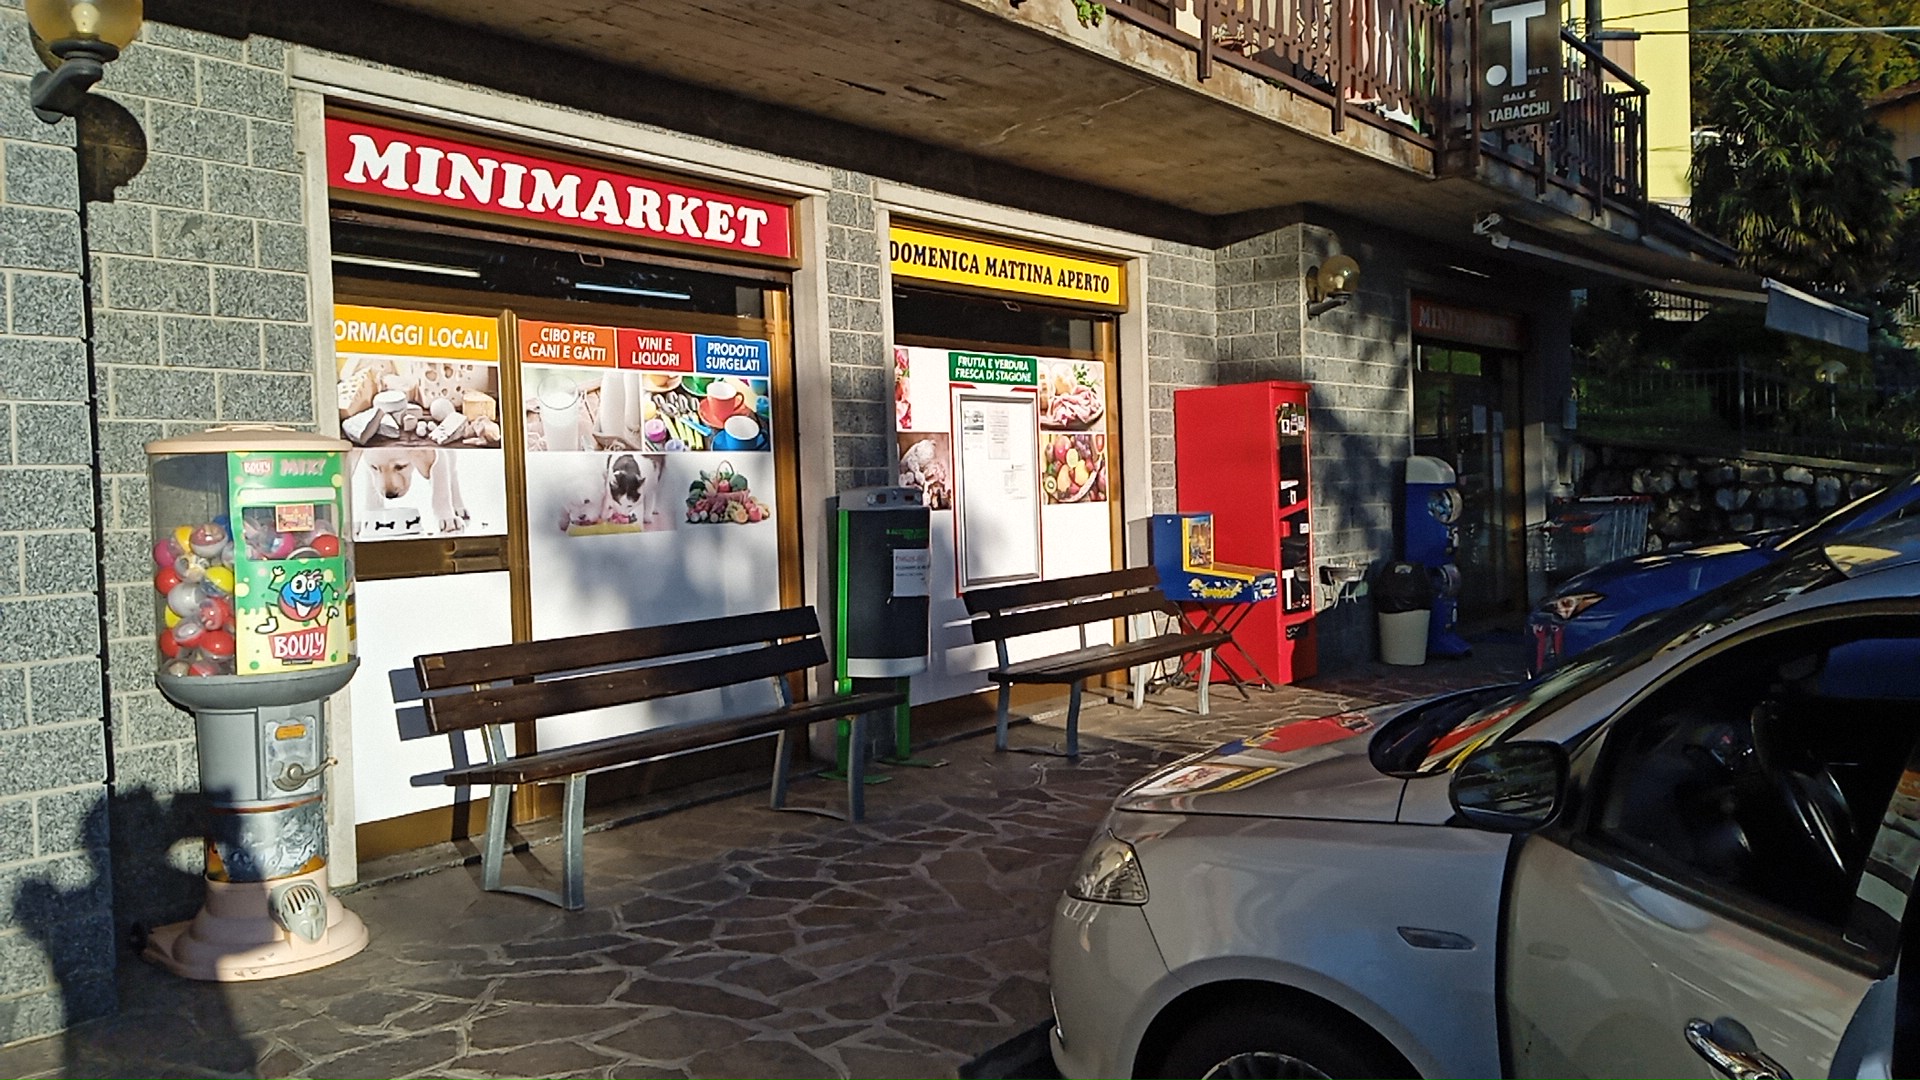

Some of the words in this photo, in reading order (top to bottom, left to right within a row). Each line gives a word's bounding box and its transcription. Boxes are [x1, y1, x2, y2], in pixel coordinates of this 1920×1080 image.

[1491, 0, 1546, 87] T
[1502, 91, 1526, 103] SALI
[1528, 89, 1537, 98] E
[1488, 101, 1550, 123] TABACCHI
[343, 133, 769, 247] MINIMARKET
[889, 240, 980, 275] DOMENICA
[984, 256, 1053, 286] MATTINA
[1057, 269, 1110, 294] APERTO
[428, 326, 489, 350] LOCALI
[540, 327, 570, 343] CIBO
[573, 330, 596, 346] PER
[637, 336, 663, 351] VINI
[665, 337, 673, 351] E
[529, 342, 560, 359] CANI
[562, 345, 571, 359] E
[573, 346, 607, 361] GATTI
[632, 351, 680, 366] LIQUORI
[707, 342, 759, 358] PRODOTTI
[706, 355, 760, 371] SURGELATI
[957, 355, 986, 369] FRUTTA
[988, 358, 993, 369] E
[994, 358, 1029, 371] VERDURA
[955, 367, 984, 380] FRESCA
[986, 370, 995, 381] DI
[995, 371, 1032, 383] STAGIONE
[273, 632, 325, 658] BOULY
